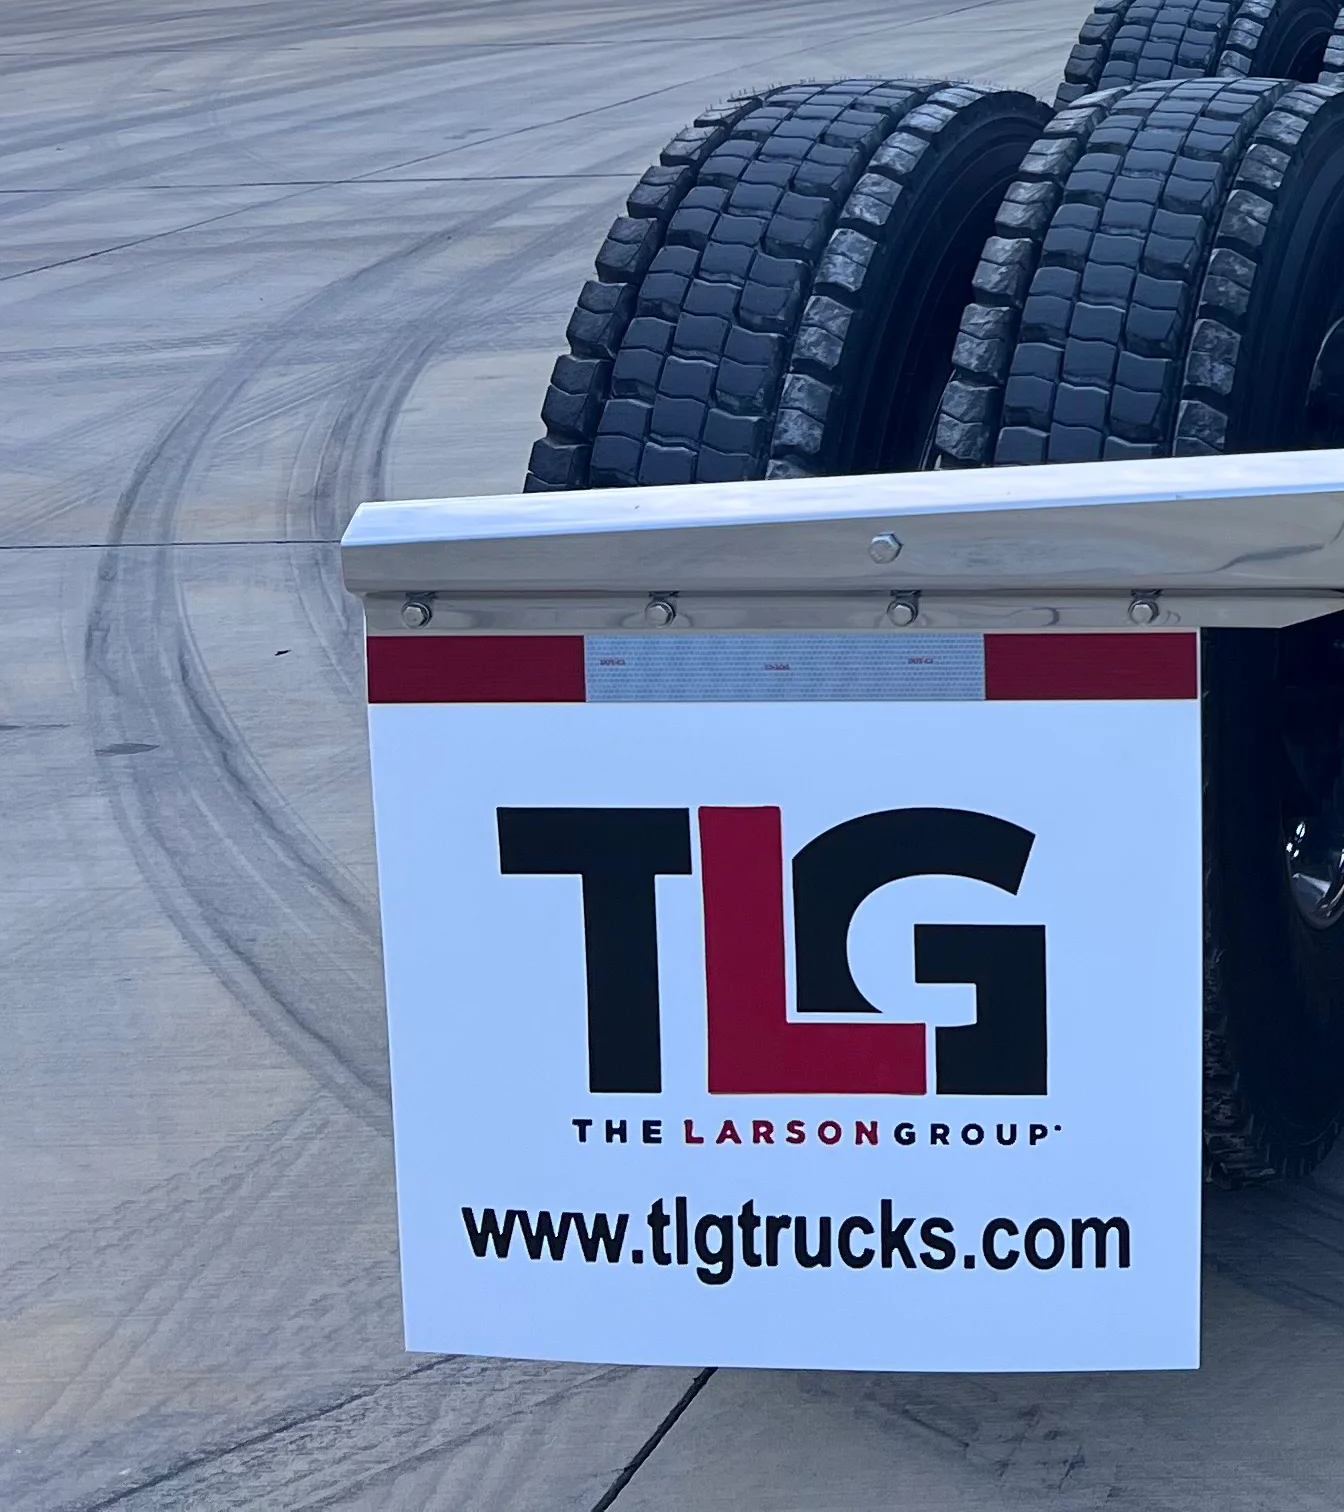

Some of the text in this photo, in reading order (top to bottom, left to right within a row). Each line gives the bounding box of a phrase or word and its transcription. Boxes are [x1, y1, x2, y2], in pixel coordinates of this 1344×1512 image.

[495, 805, 1049, 1097] TLG
[571, 1118, 663, 1145] THE
[683, 1119, 879, 1146] LARSON
[460, 1195, 1131, 1286] www.tlgtrucks.com
